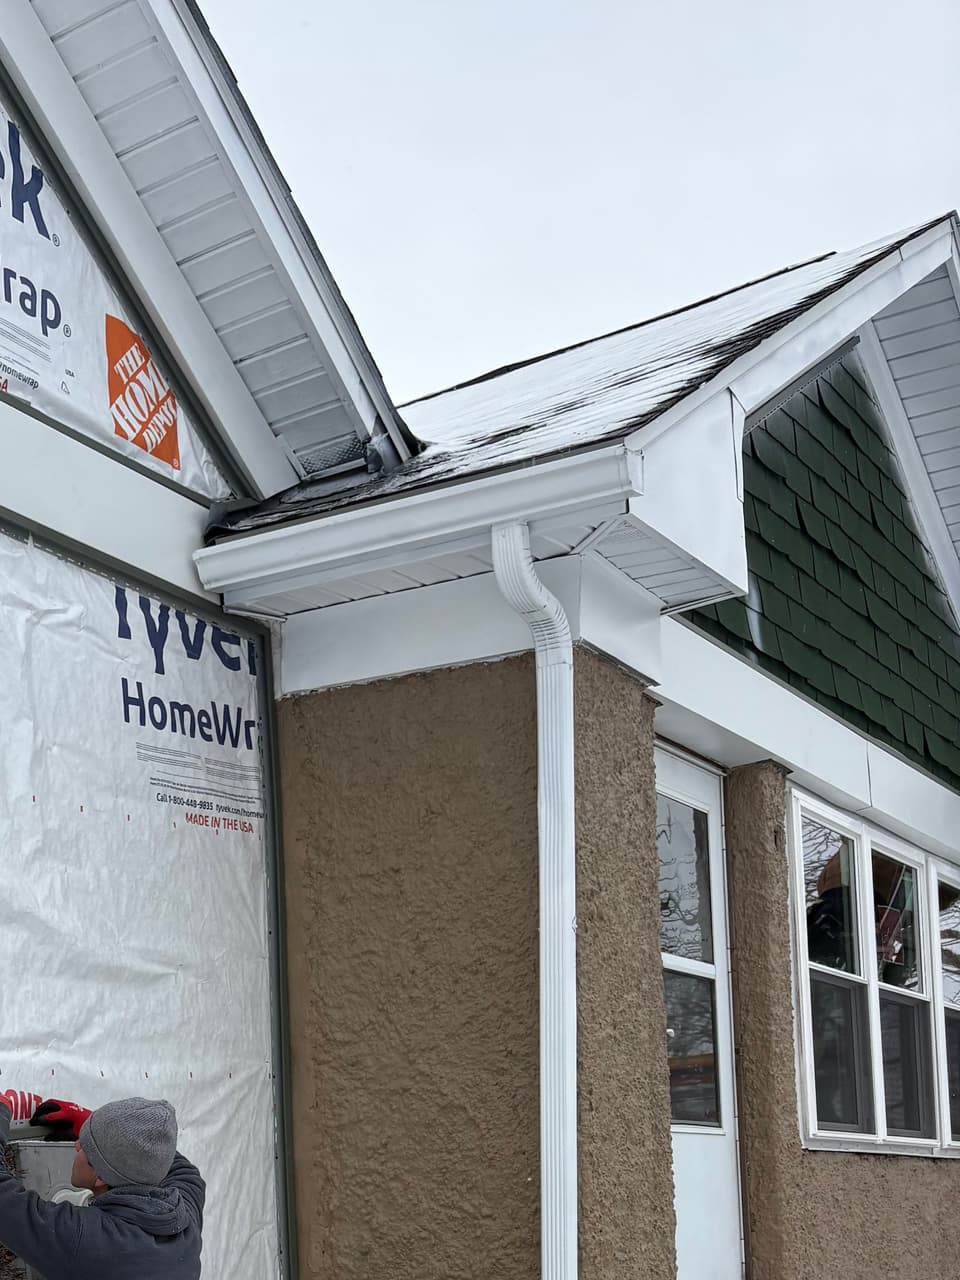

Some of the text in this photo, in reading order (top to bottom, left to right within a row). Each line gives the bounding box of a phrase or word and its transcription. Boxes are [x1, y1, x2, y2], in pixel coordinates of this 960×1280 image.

[156, 792, 168, 804] Call
[185, 812, 210, 828] MADE
[223, 818, 239, 831] THE
[240, 820, 254, 834] USA
